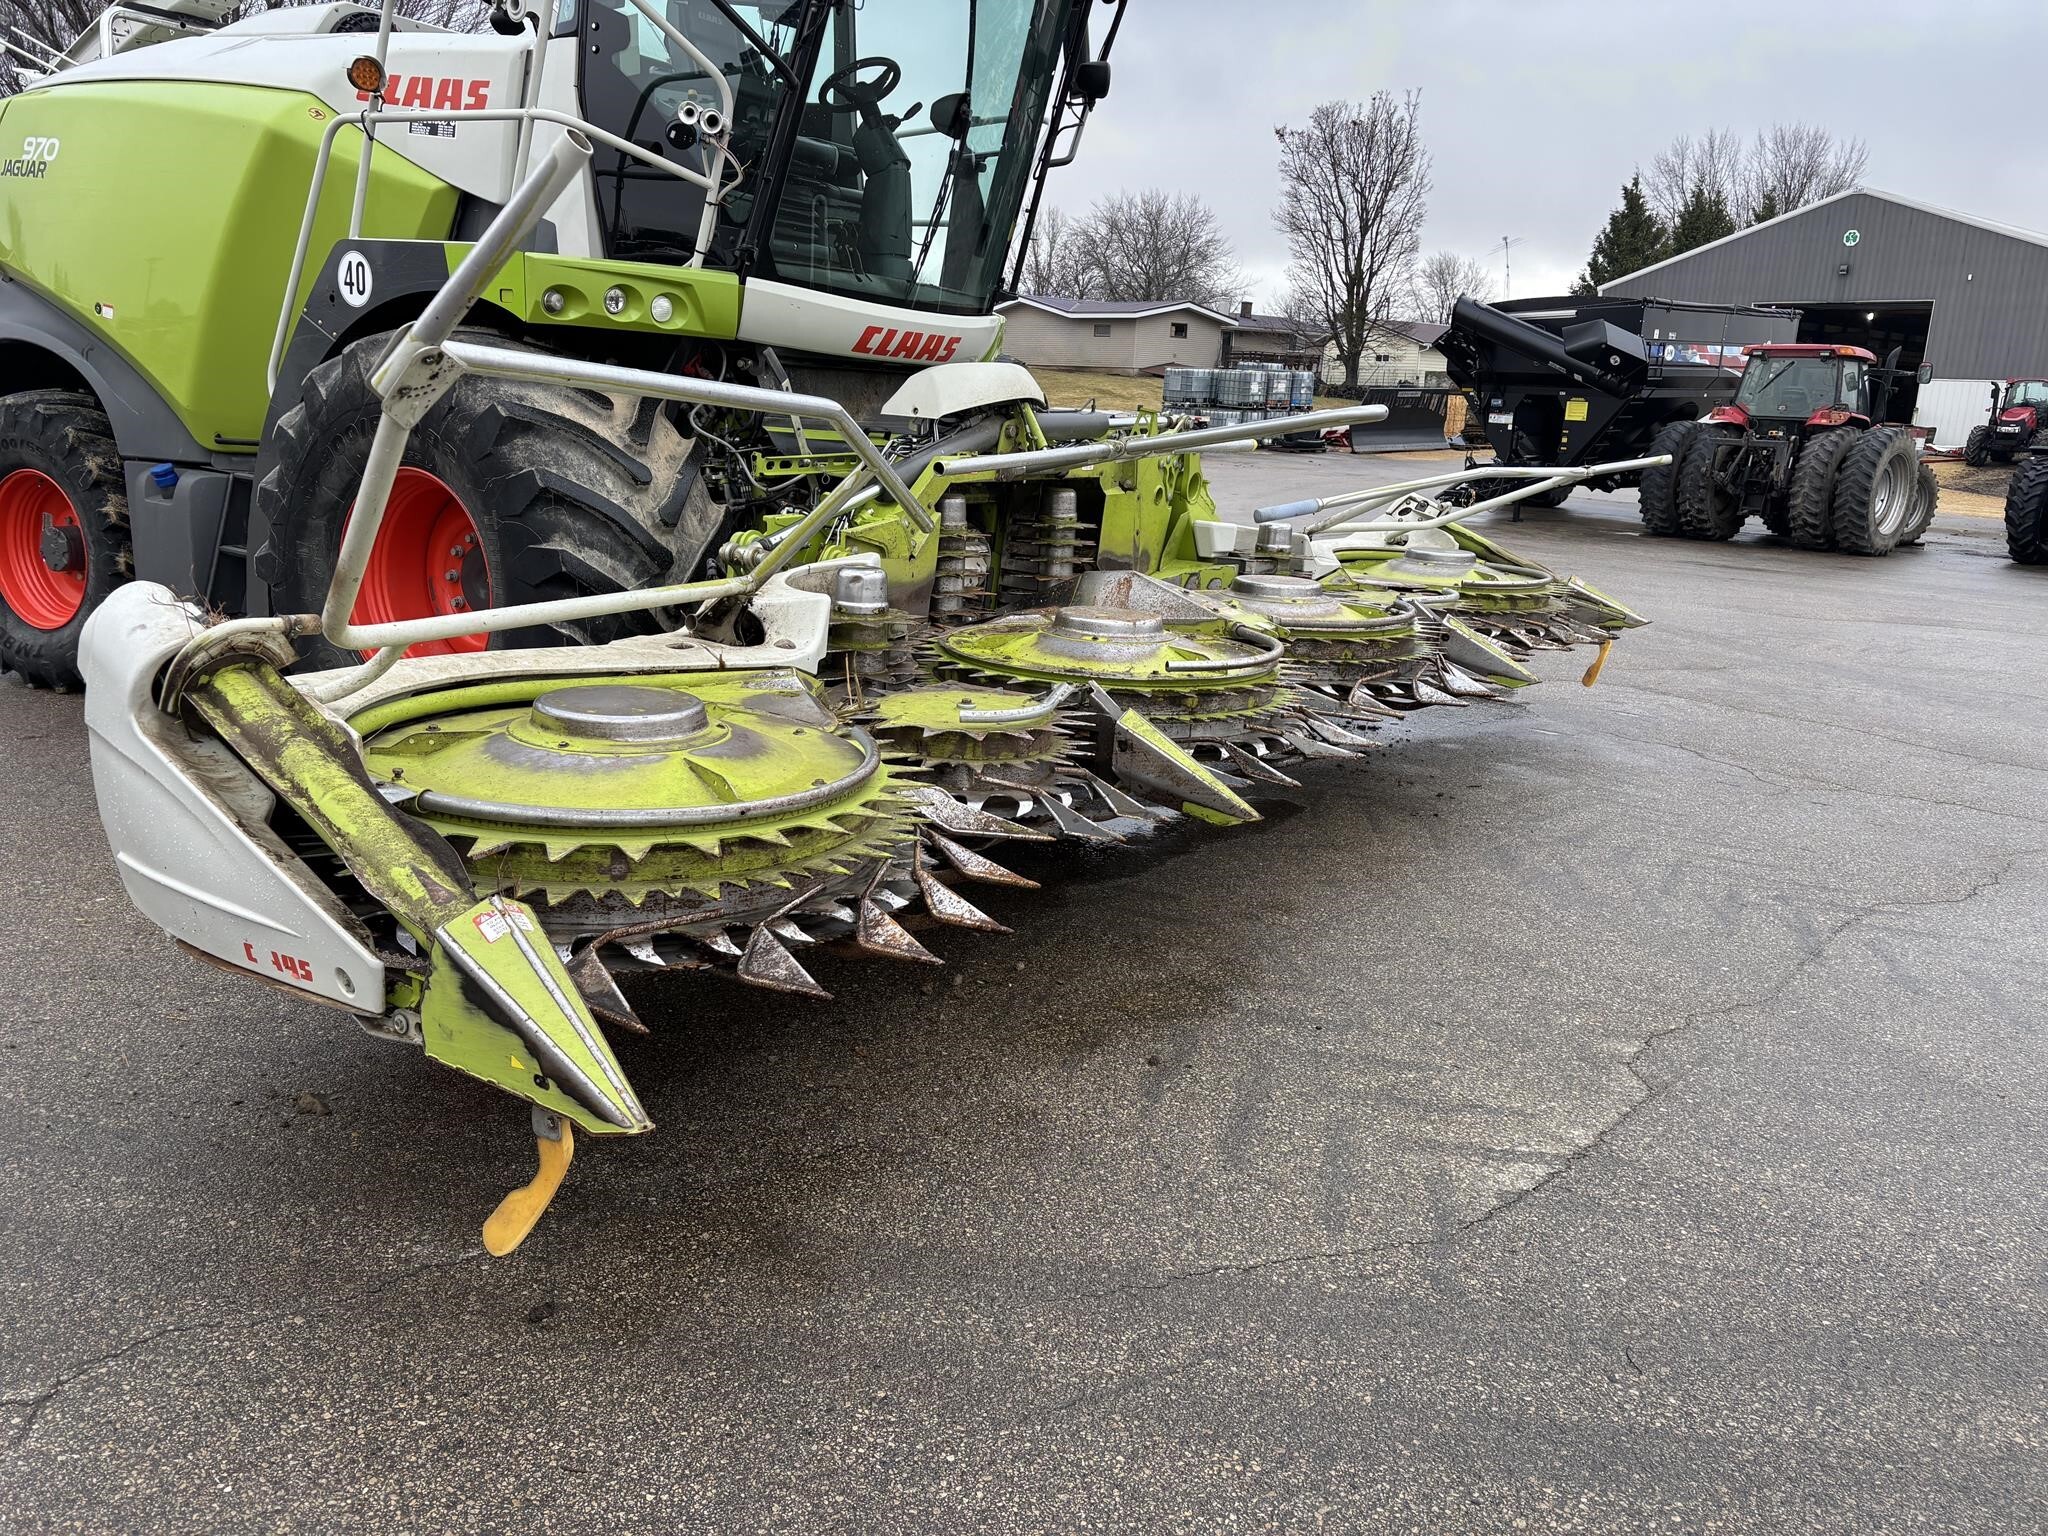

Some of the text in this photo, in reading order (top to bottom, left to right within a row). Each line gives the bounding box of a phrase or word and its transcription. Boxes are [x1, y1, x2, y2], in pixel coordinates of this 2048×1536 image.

[22, 136, 60, 161] 970
[0, 159, 47, 179] JAGUAR
[344, 260, 366, 296] 40
[851, 325, 962, 362] CLAAS
